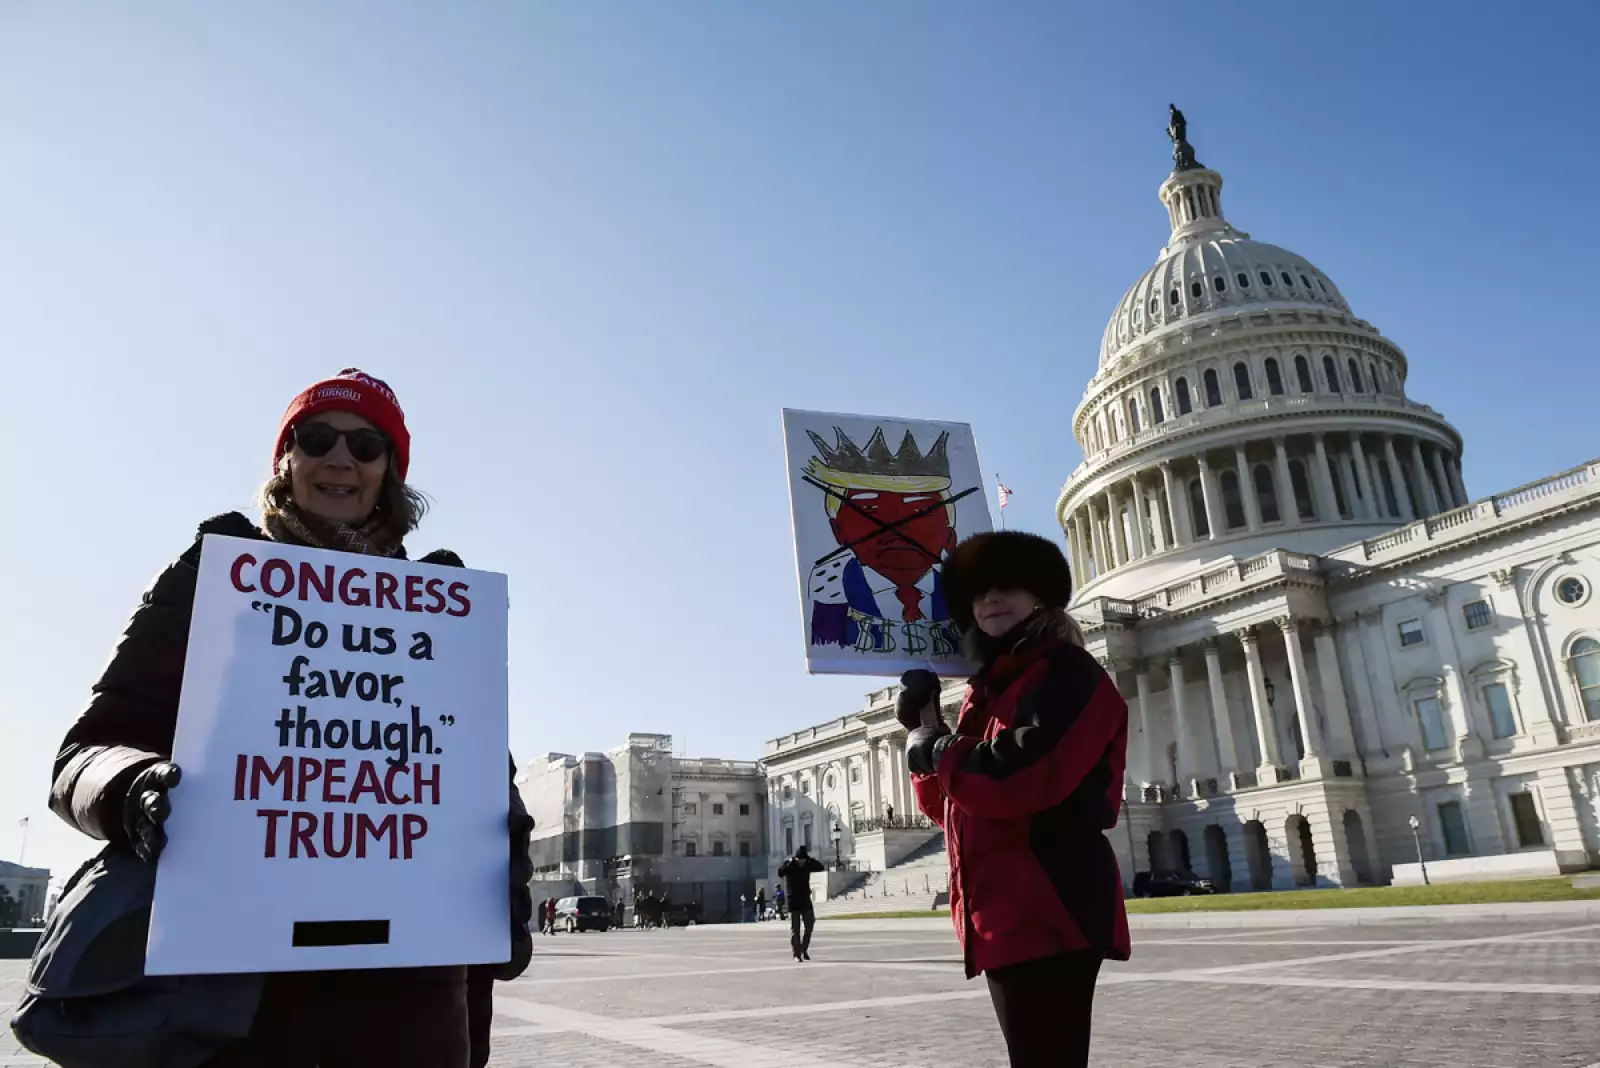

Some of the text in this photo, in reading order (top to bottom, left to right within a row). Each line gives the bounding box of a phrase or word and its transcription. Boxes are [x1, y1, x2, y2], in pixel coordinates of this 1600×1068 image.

[230, 549, 471, 617] CONGRESS
[252, 601, 434, 660] “Do us a
[283, 656, 404, 708] favor,
[275, 705, 455, 766] though.”
[233, 754, 440, 805] IMPEACH
[256, 809, 428, 860] TRUMP
